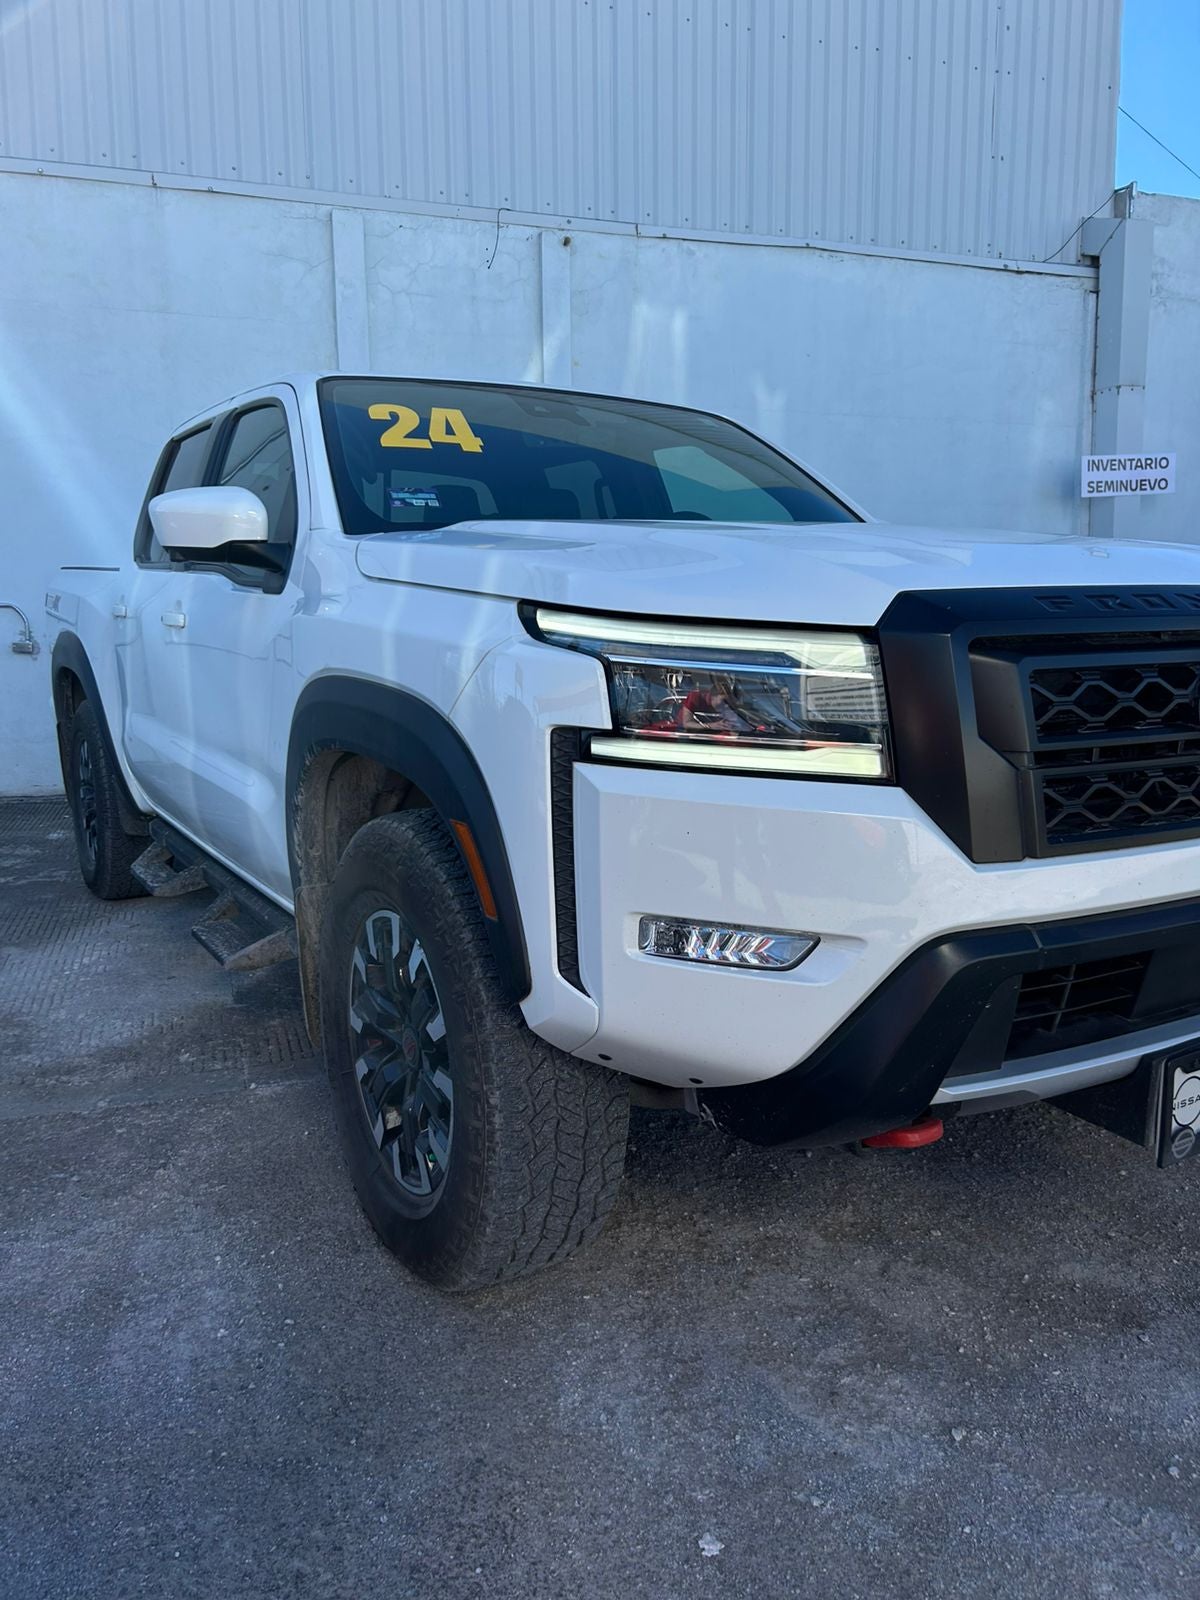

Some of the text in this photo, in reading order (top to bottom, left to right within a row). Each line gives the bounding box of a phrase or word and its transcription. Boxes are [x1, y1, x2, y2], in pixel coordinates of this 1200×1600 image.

[368, 403, 484, 453] 24
[1087, 457, 1169, 472] INVENTARIO
[1087, 478, 1168, 493] SEMINUEVO
